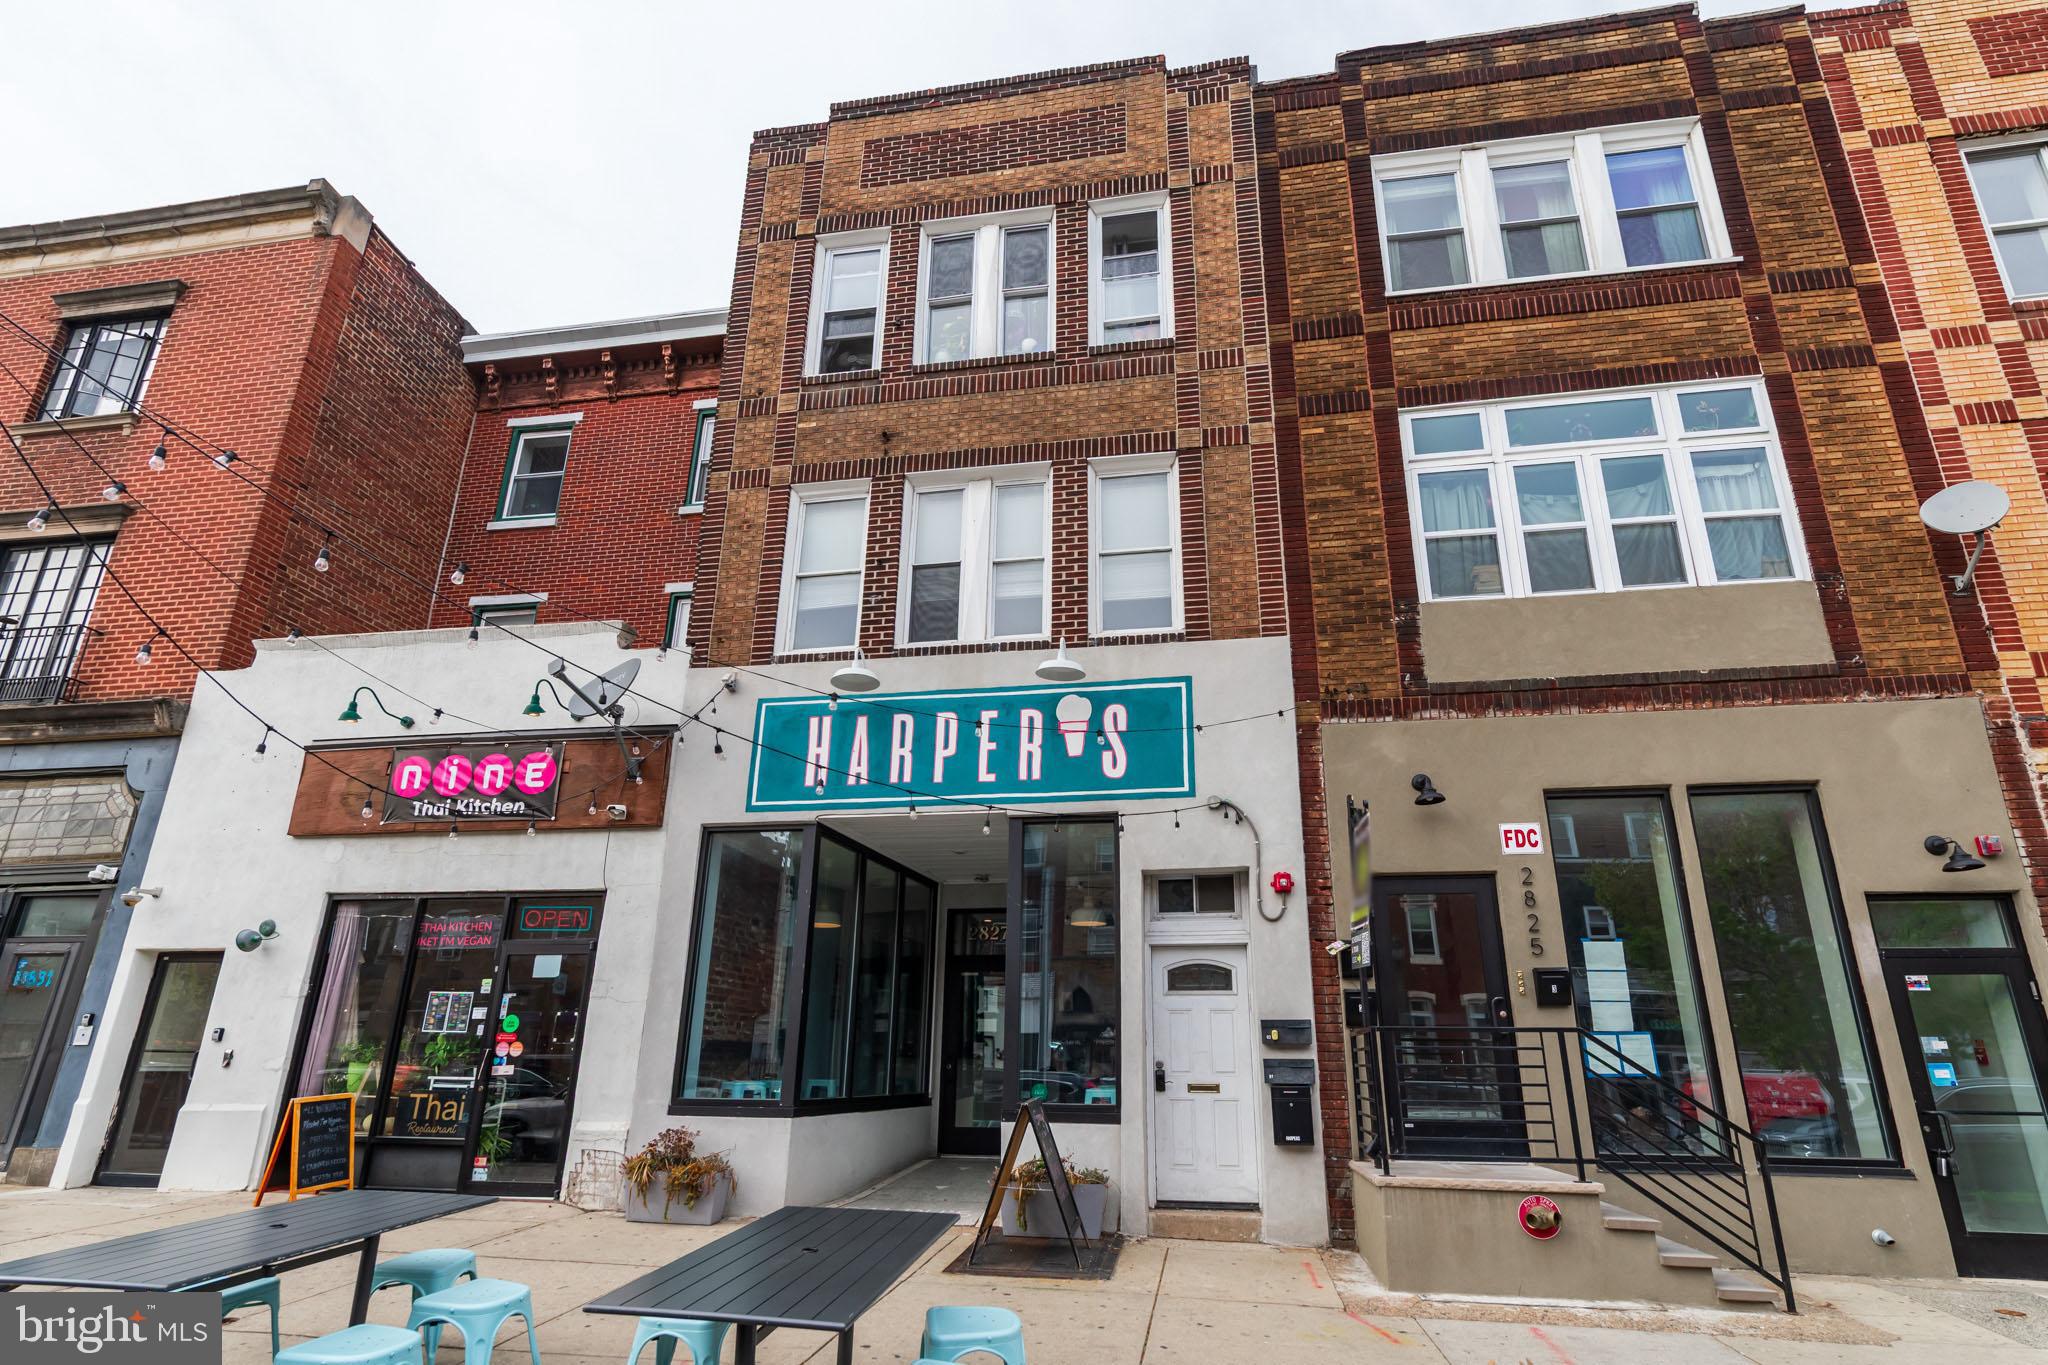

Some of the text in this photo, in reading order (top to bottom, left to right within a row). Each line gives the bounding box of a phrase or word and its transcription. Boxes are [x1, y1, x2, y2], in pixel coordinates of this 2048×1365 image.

[412, 798, 525, 817] Thai Kitchen
[1503, 828, 1539, 849] FDC
[525, 909, 588, 928] OPEN
[1520, 866, 1544, 956] 2825
[449, 920, 493, 933] KITCHEN
[457, 934, 493, 946] VEGAN
[410, 1093, 467, 1121] Thai
[407, 1121, 459, 1136] Restaurant
